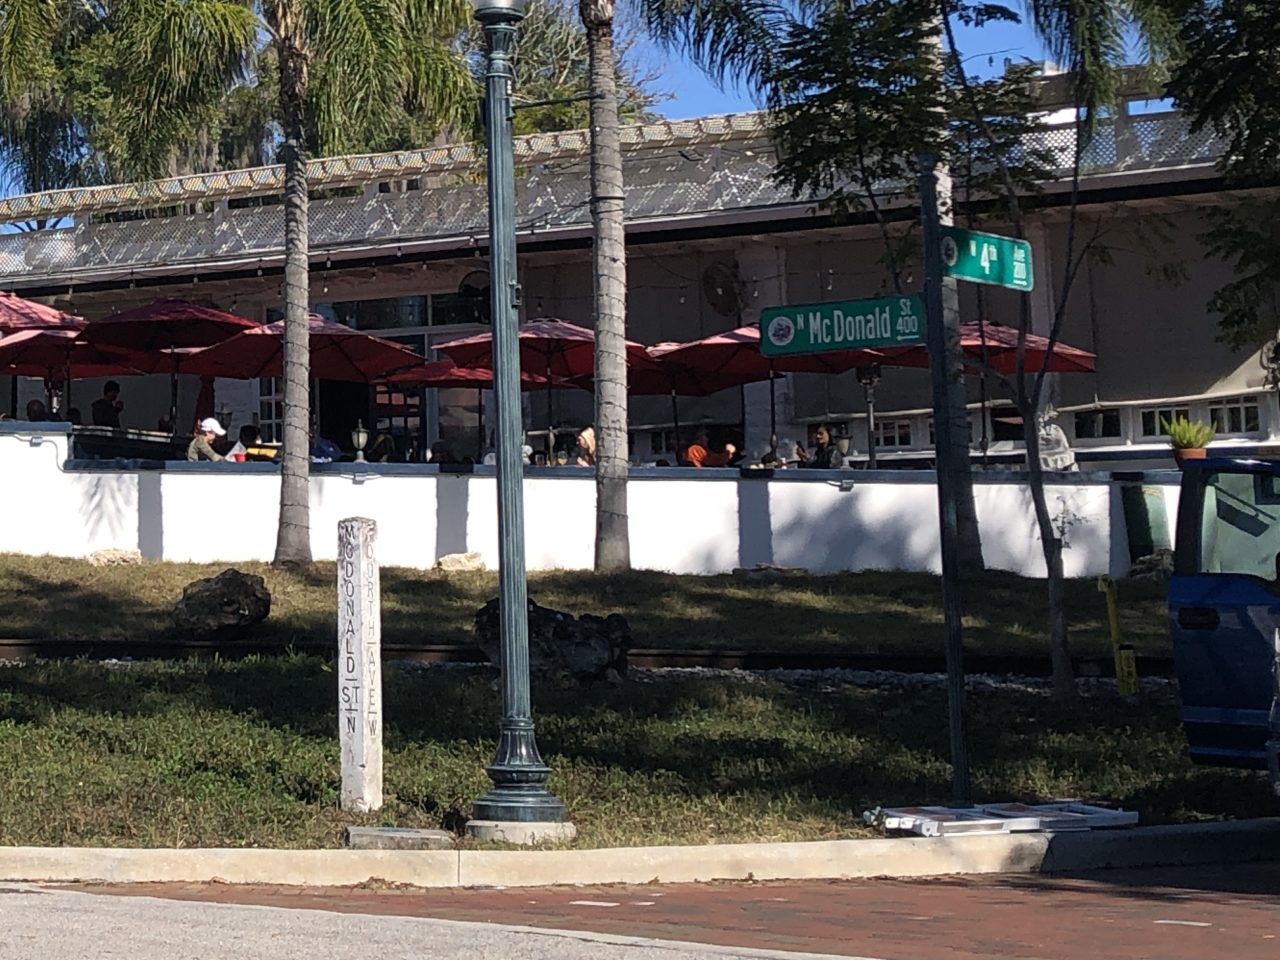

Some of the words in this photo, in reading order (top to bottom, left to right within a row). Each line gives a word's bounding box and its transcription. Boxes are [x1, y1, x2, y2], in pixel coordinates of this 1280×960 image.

[899, 298, 913, 316] St
[797, 313, 805, 331] N
[896, 315, 919, 334] 400
[368, 649, 376, 706] AVE
[341, 685, 361, 704] ST
[347, 716, 356, 734] N
[368, 719, 378, 737] W
